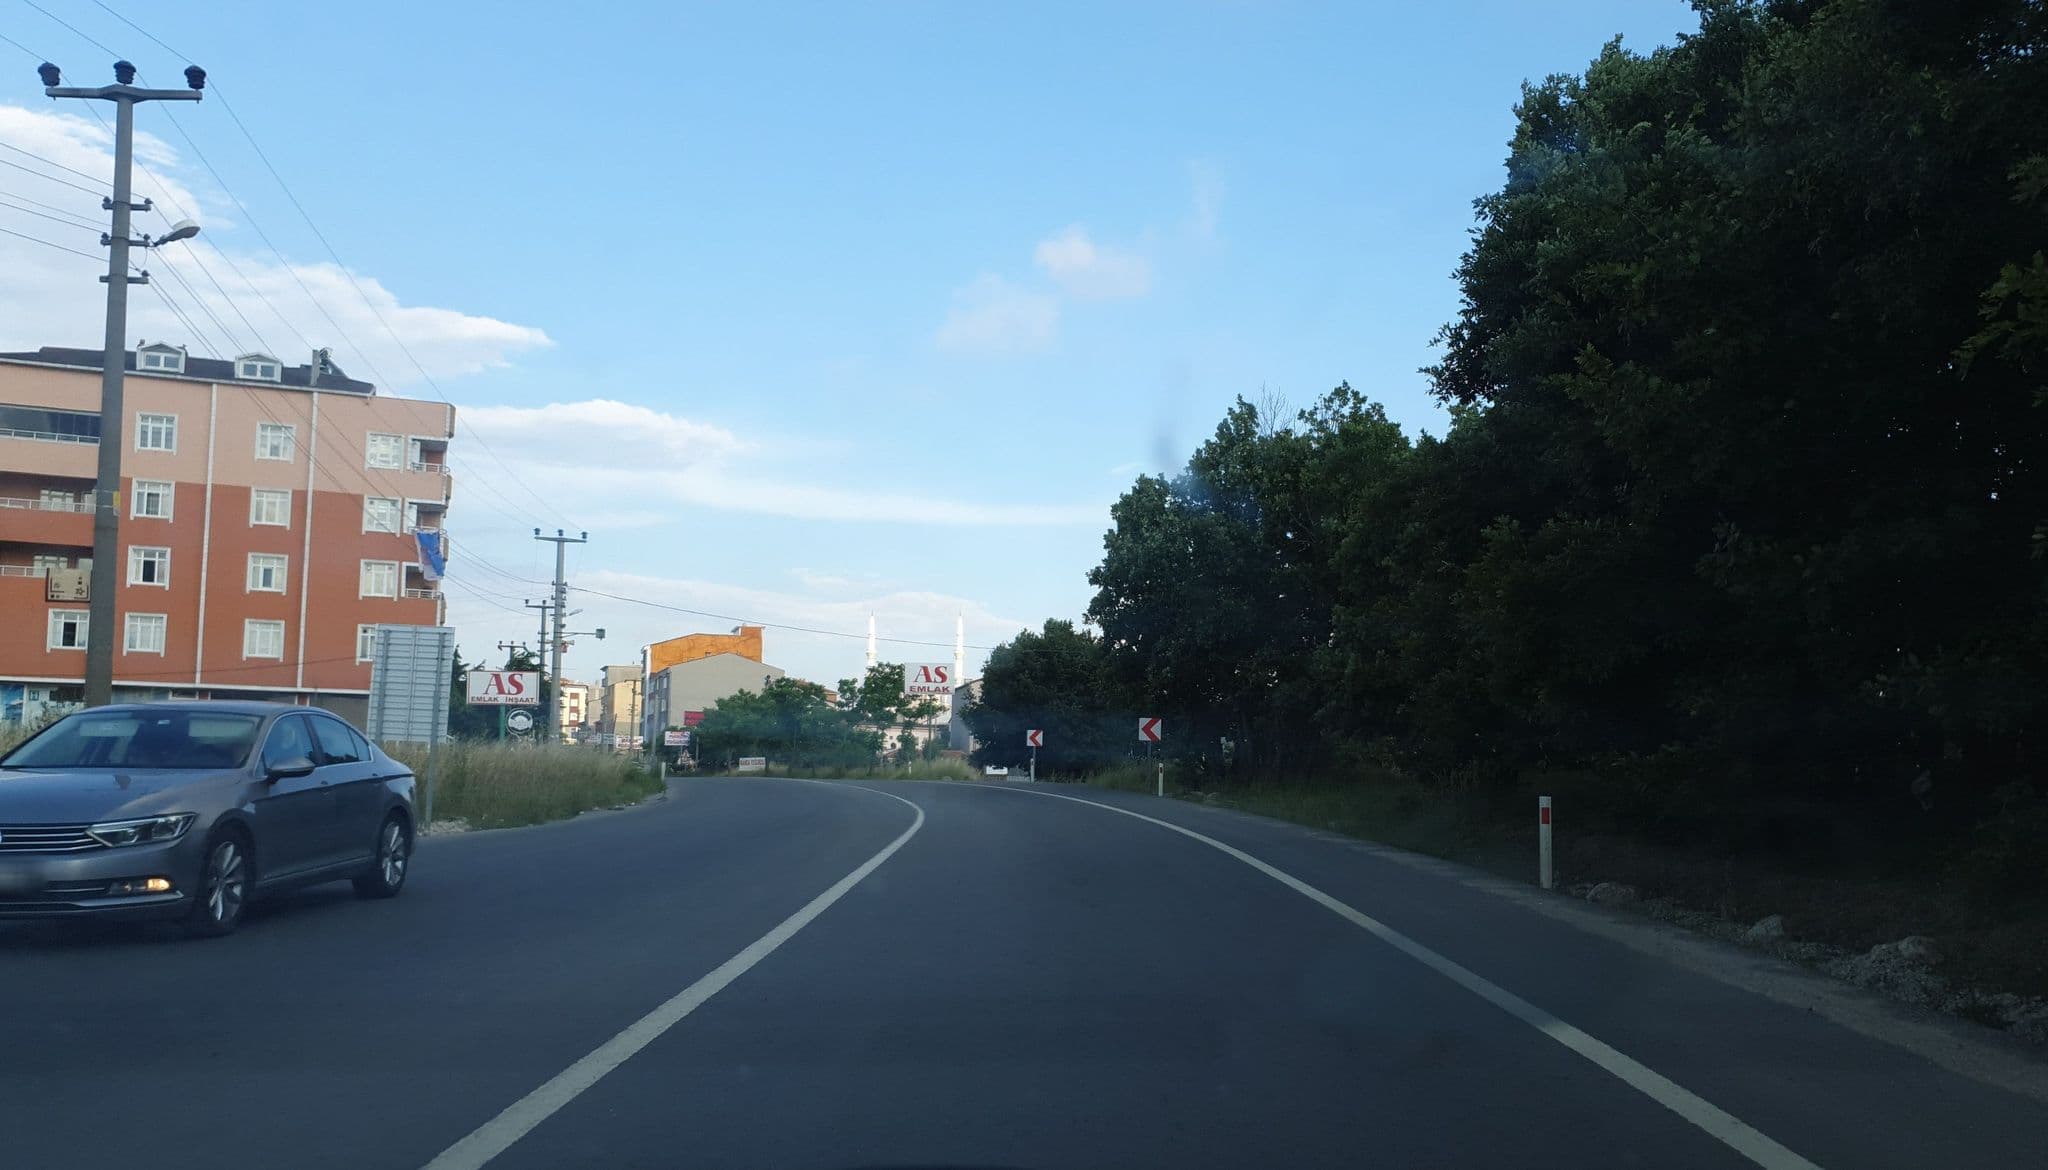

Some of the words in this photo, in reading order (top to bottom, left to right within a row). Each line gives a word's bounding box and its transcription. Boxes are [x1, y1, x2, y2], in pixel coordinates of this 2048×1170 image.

[483, 673, 524, 695] AS
[912, 665, 949, 684] AS
[909, 685, 950, 693] EMLAK
